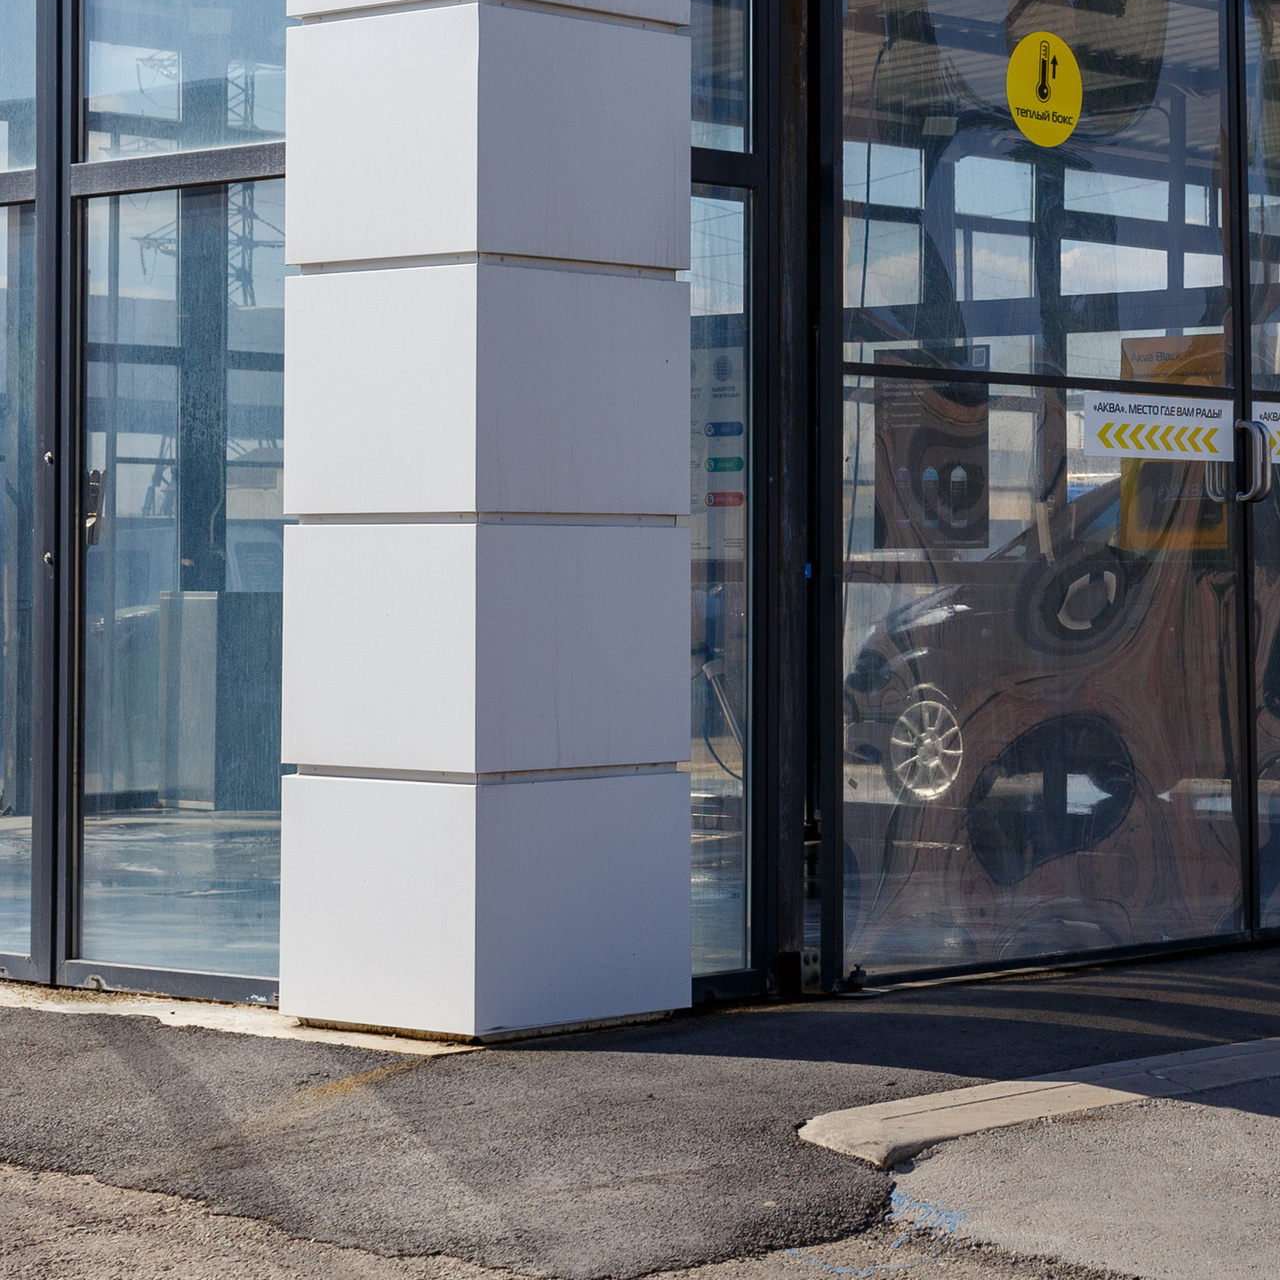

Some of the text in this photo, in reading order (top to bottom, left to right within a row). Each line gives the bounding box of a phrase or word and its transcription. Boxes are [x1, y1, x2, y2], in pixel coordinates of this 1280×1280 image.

[1015, 106, 1074, 126] теплый бокс
[1128, 404, 1159, 416] МЕСТО
[1160, 405, 1175, 417] ГДЕ
[1176, 406, 1195, 418] ВАМ
[1195, 408, 1223, 419] РАДЫ!
